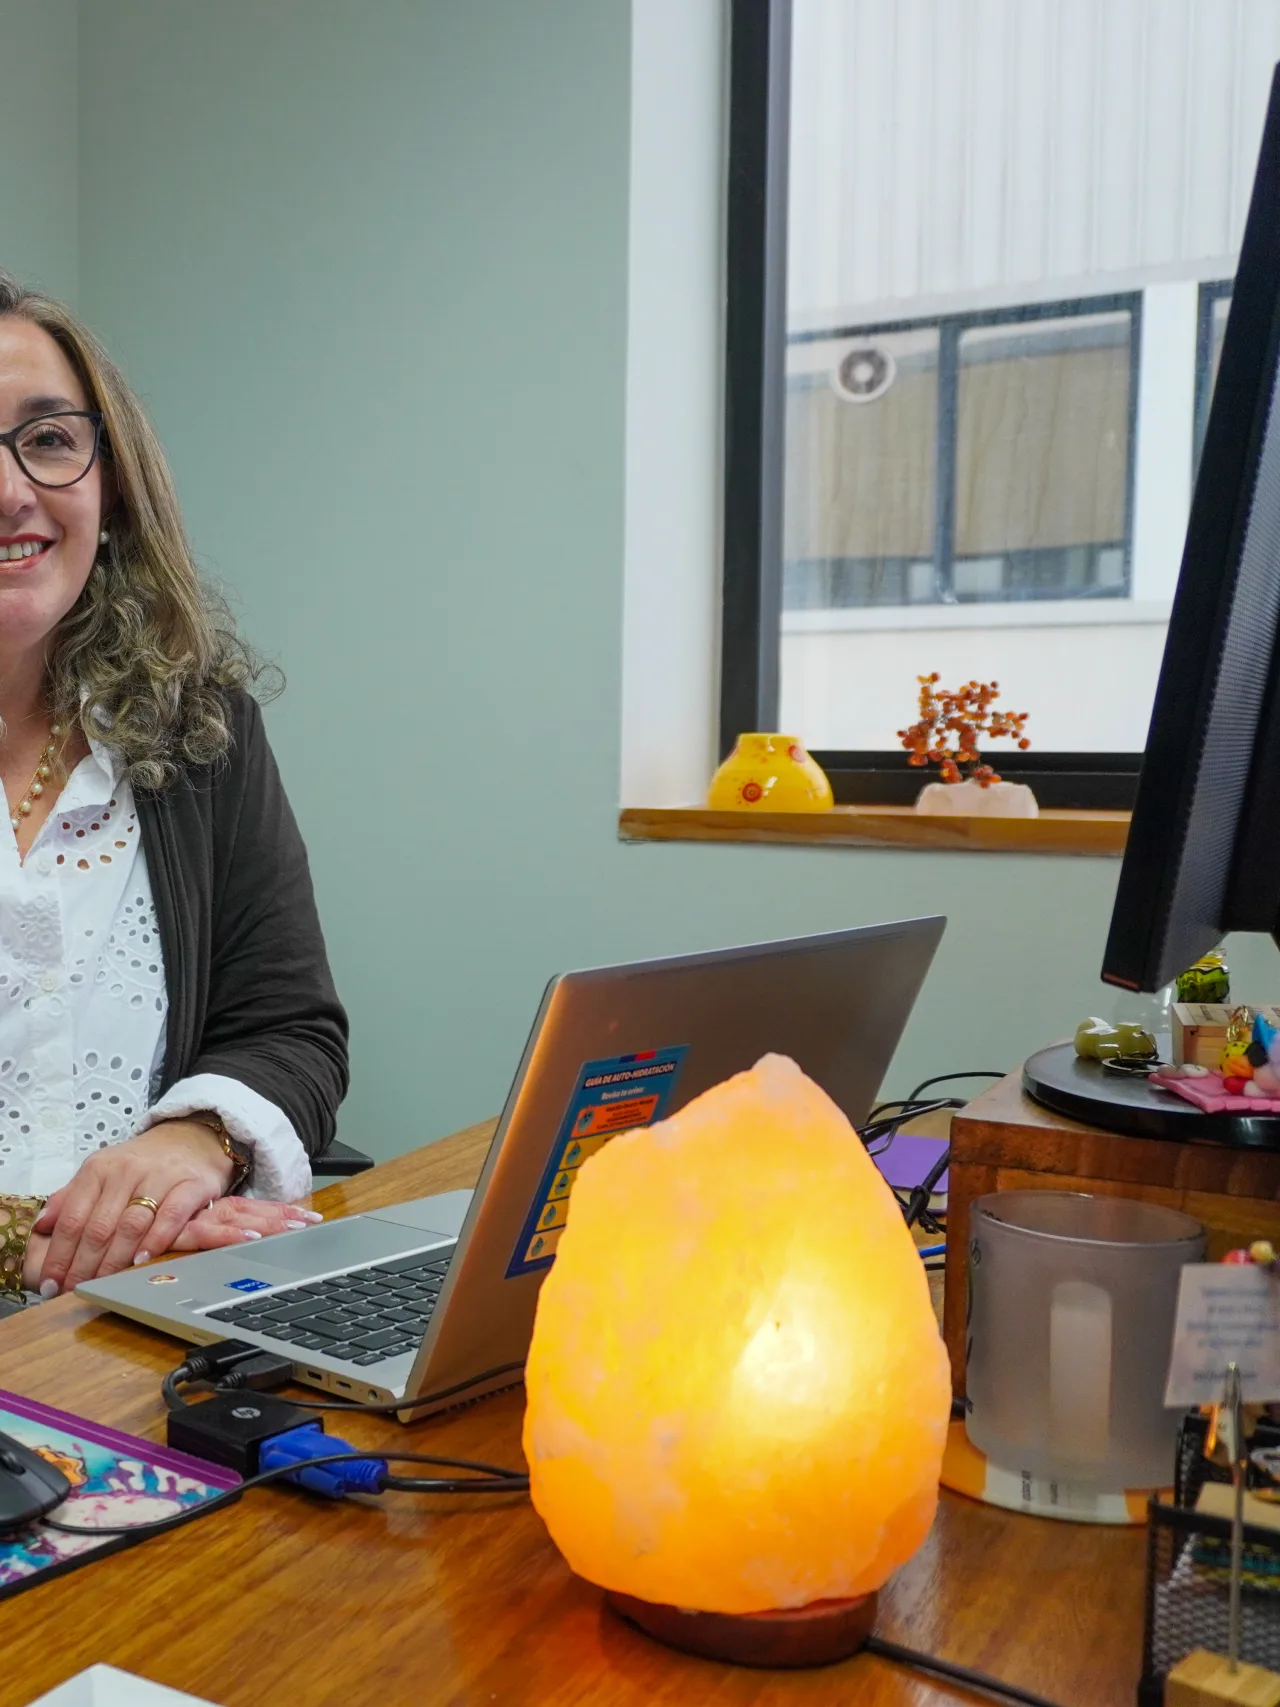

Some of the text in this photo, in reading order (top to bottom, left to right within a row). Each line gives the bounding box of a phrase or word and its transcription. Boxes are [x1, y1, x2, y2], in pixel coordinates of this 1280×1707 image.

[585, 1063, 675, 1087] GUÍA DE AUTO-HIDRATACIÓN
